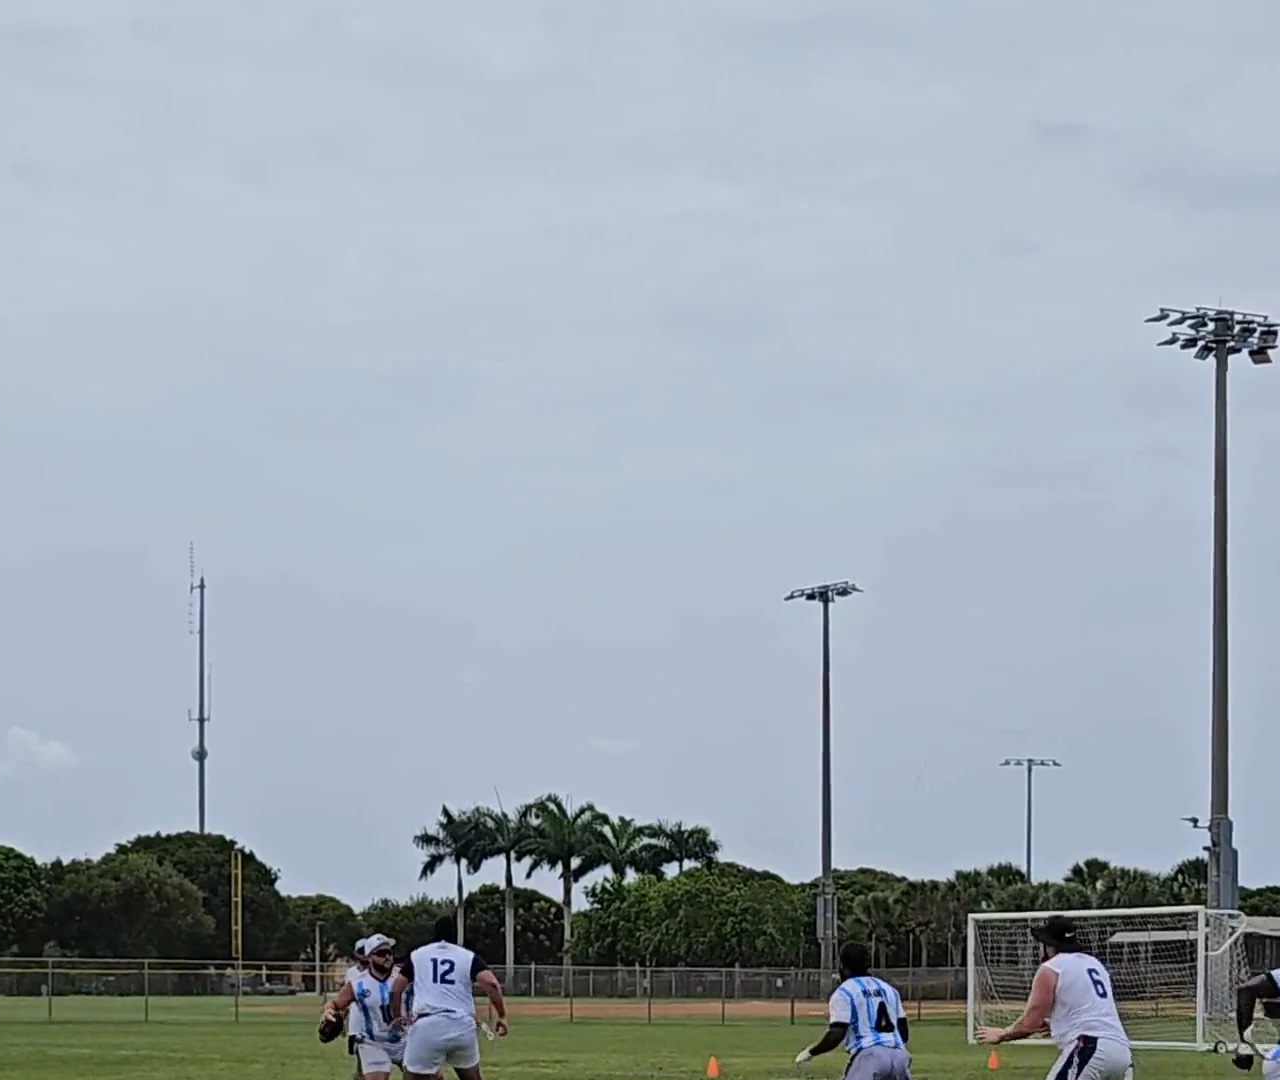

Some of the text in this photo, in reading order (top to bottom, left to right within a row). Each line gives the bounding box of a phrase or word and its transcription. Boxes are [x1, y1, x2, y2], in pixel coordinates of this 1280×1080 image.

[430, 957, 456, 985] 12
[1086, 967, 1108, 999] 6
[874, 1000, 896, 1033] 4
